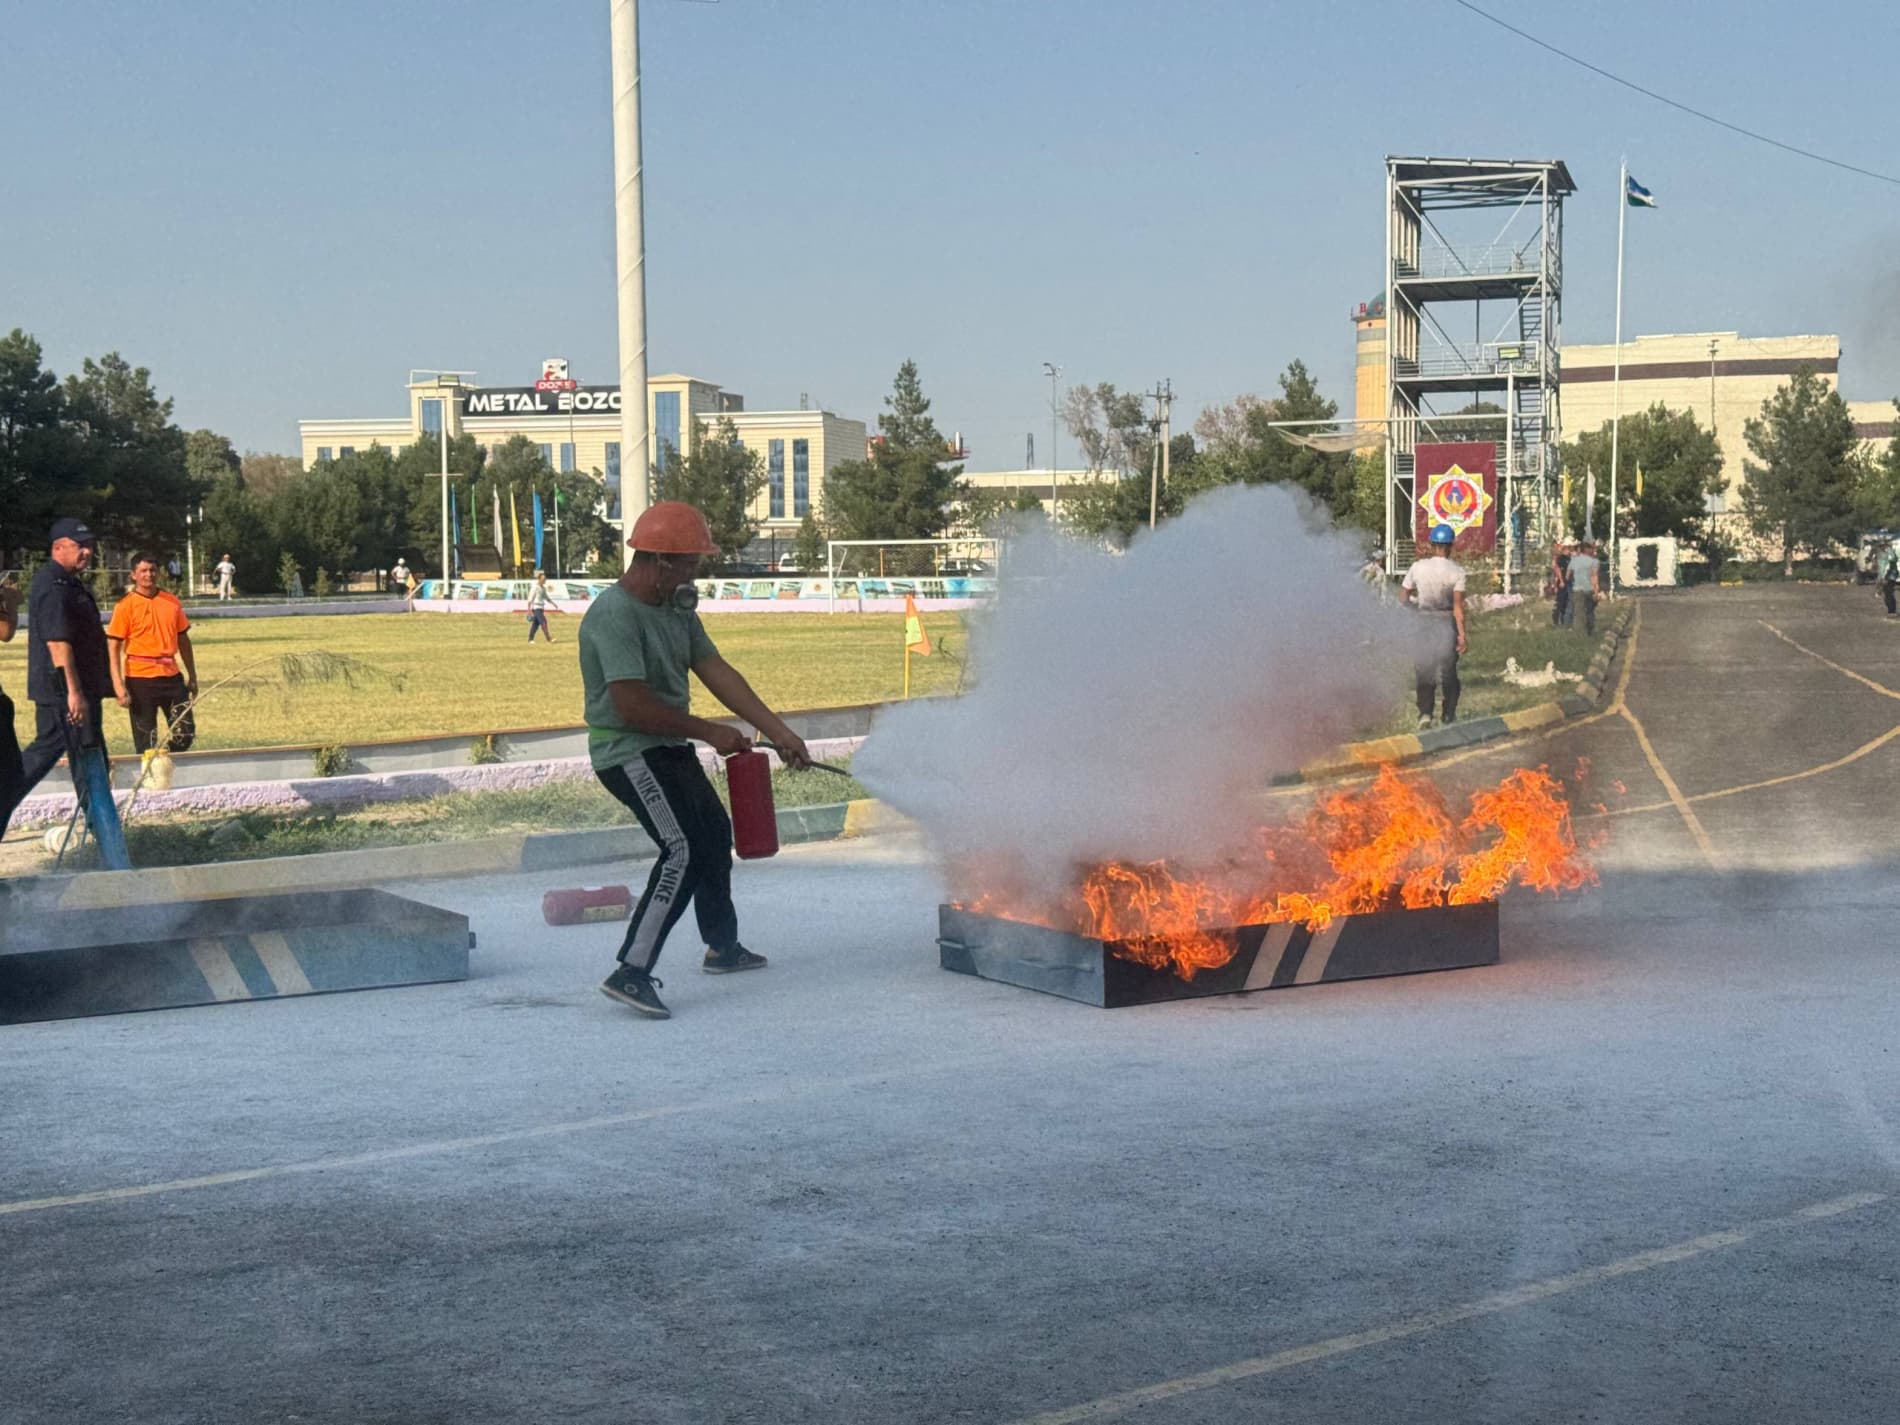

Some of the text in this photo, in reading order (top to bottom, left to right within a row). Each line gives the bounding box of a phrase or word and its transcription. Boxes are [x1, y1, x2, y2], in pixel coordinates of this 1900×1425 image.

[469, 391, 621, 412] METAL BOZO
[636, 770, 662, 806] NIKE
[654, 866, 680, 905] NIKE
